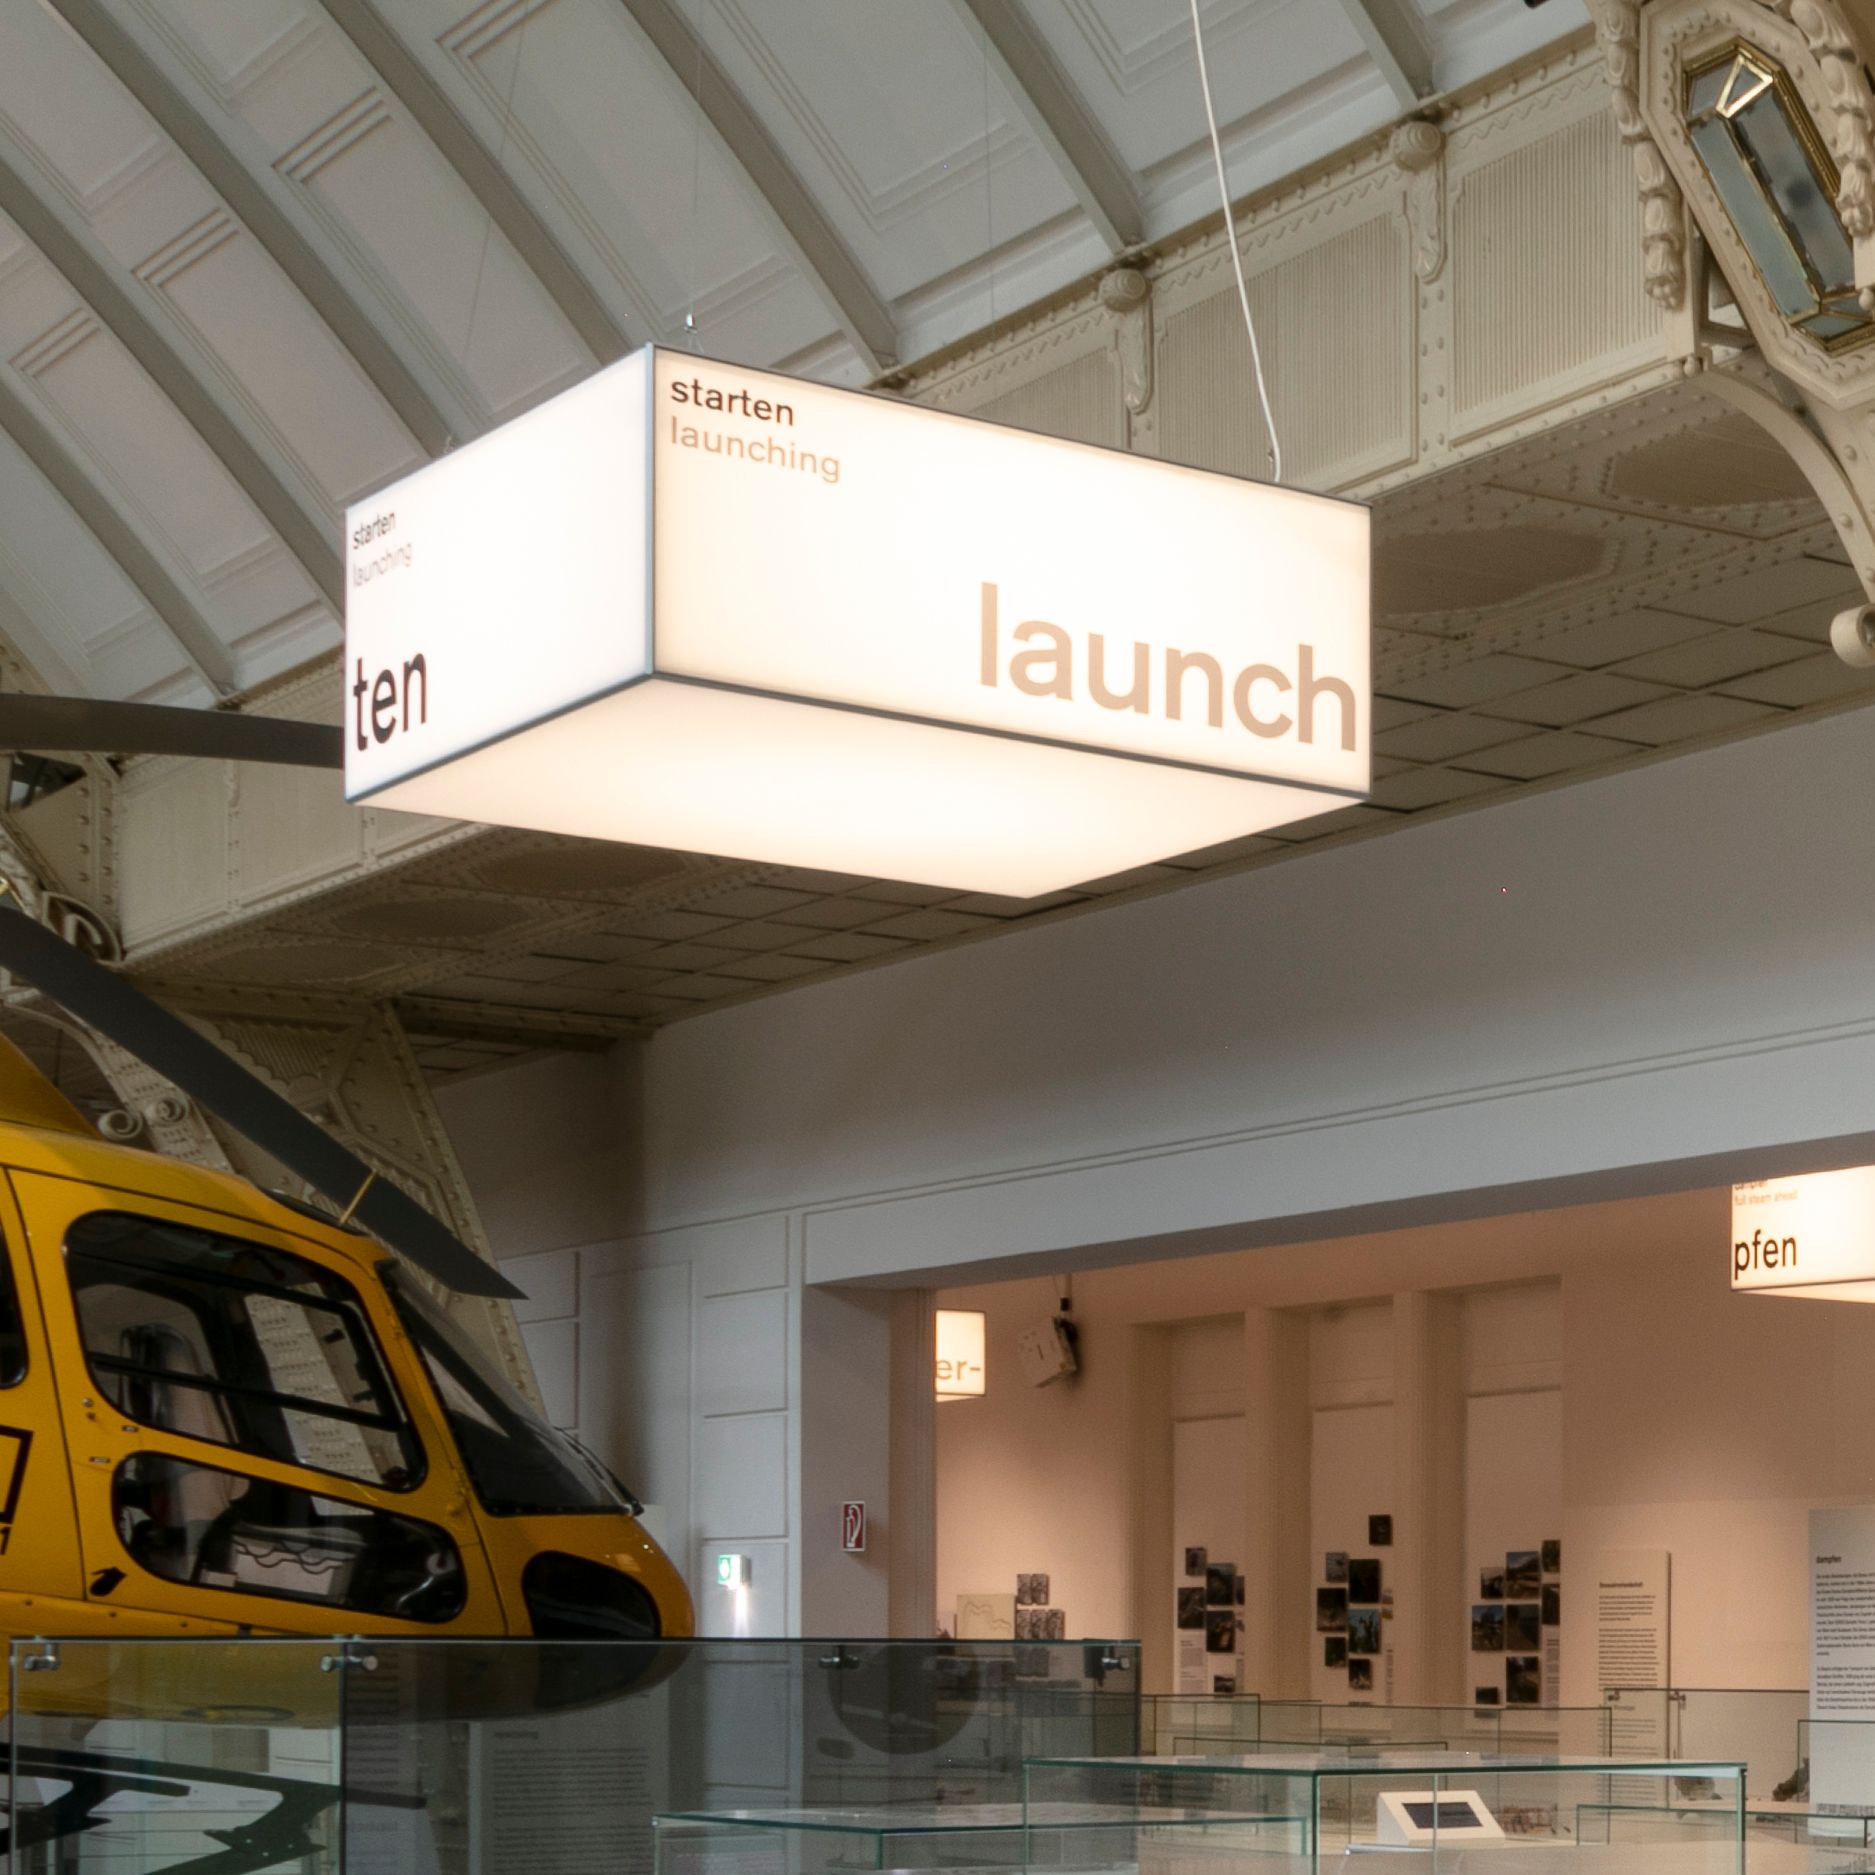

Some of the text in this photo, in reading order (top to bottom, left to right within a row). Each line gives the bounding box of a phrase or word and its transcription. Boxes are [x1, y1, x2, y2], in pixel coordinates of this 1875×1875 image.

[671, 378, 794, 426] starten
[671, 415, 840, 484] launching
[353, 511, 396, 551] starten
[353, 542, 413, 587] launching
[979, 580, 1357, 752] launch
[353, 652, 428, 752] ten
[1734, 1229, 1797, 1281] pfen
